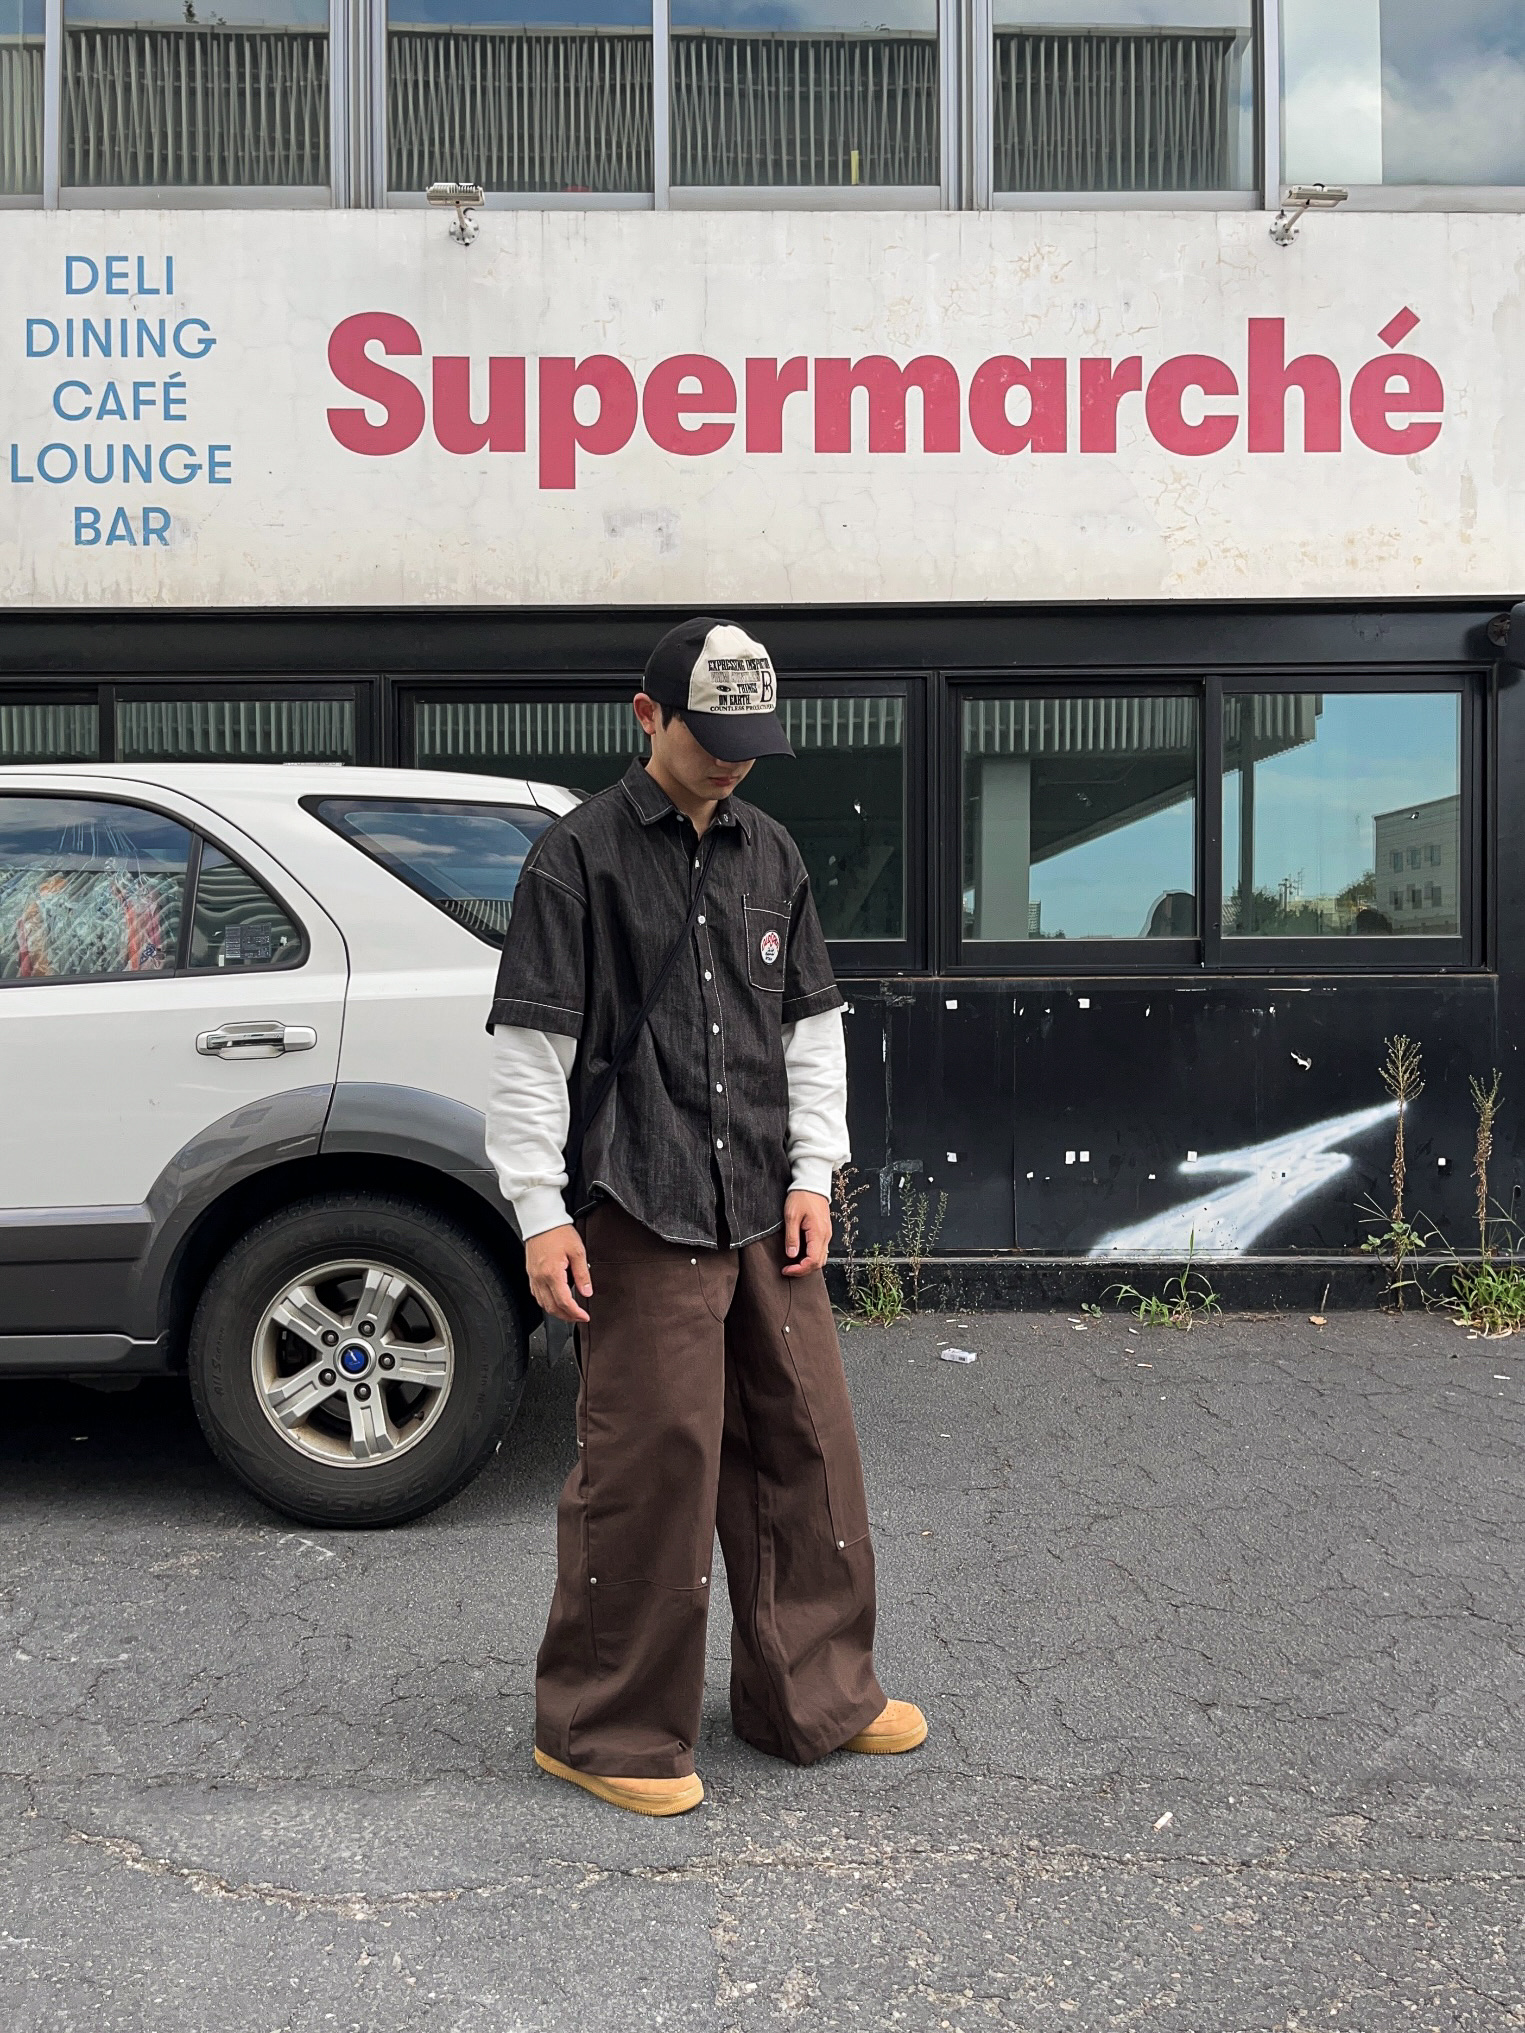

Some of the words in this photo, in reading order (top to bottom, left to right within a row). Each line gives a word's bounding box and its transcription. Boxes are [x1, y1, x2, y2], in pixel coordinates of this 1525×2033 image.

[65, 255, 173, 295] DELI
[26, 318, 217, 359] DINING
[53, 371, 187, 421] CAFÉ
[328, 308, 1444, 488] Supermarché
[11, 442, 232, 485] LOUNGE
[74, 506, 171, 546] BAR
[719, 695, 728, 705] ON
[730, 695, 751, 705] EARTH
